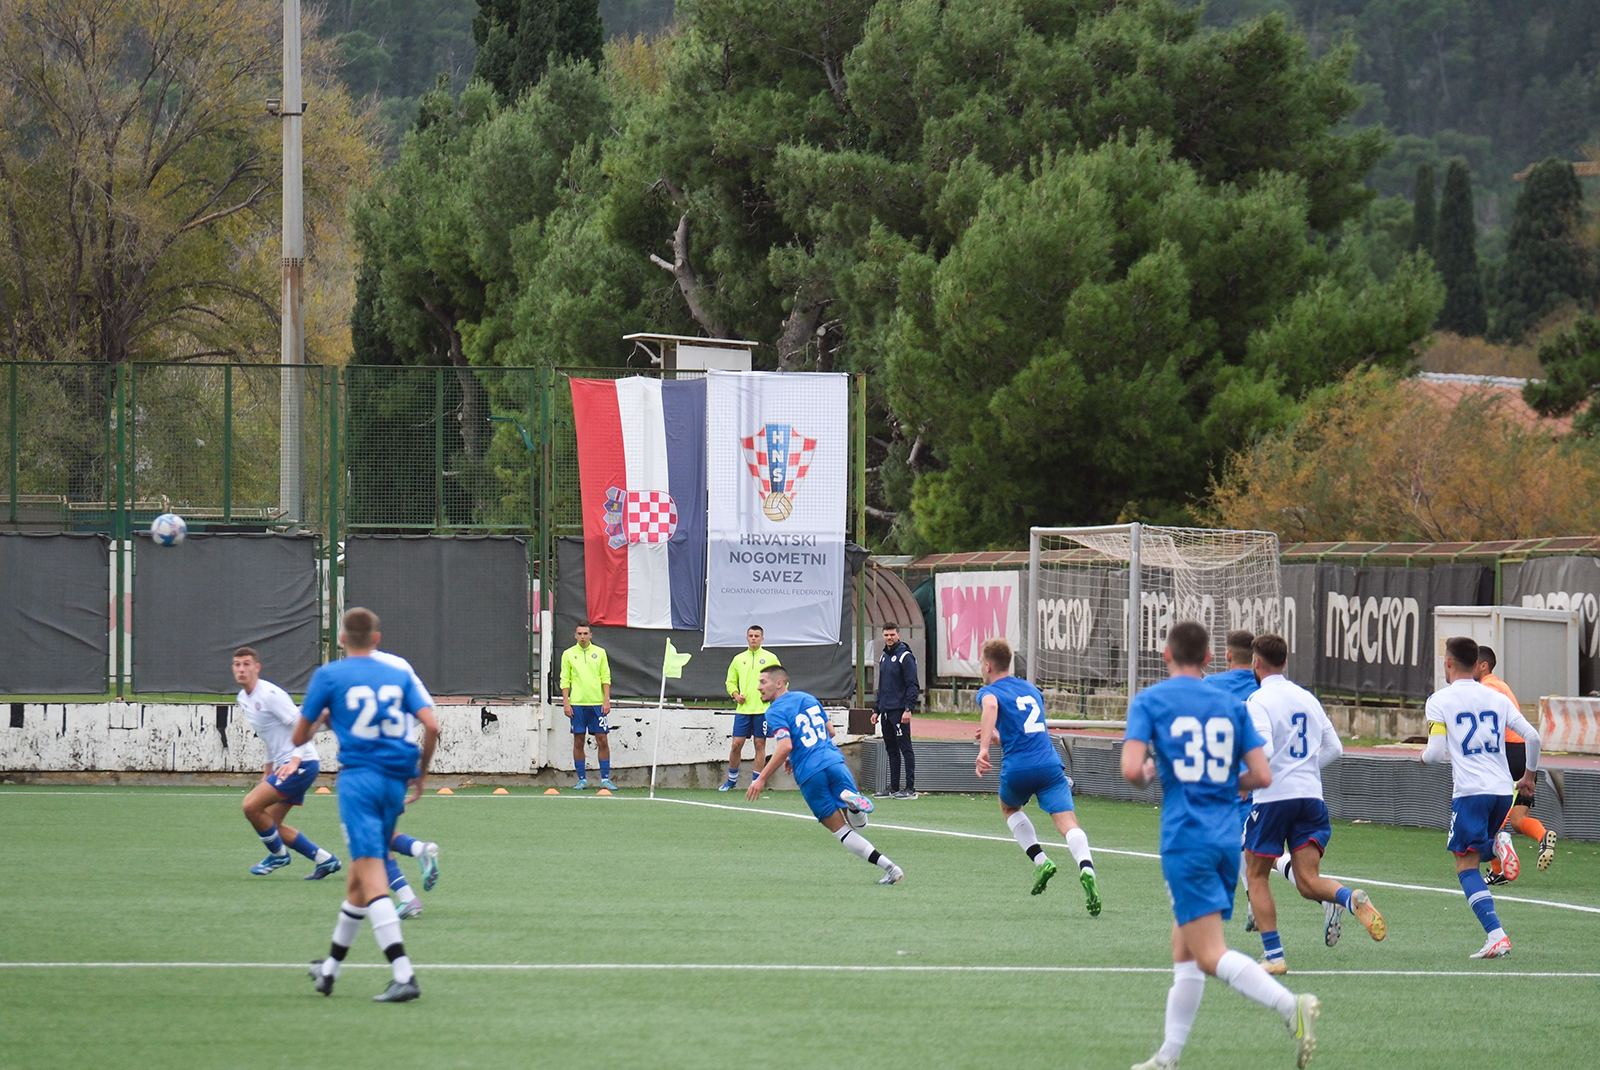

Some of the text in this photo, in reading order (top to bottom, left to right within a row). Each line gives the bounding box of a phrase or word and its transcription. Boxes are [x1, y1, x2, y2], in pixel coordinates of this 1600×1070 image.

[772, 430, 784, 483] HNS
[729, 551, 827, 566] NOGOMETNI
[740, 533, 817, 547] HRVATSKI
[720, 587, 755, 595] CROATIAN
[792, 588, 834, 596] FEDERATION
[752, 570, 804, 583] SAVEZ
[1325, 591, 1420, 666] macron
[345, 684, 408, 739] 23
[795, 704, 827, 748] 35
[1015, 695, 1046, 734] 2
[1455, 710, 1501, 756] 23
[1169, 716, 1235, 782] 39
[1289, 712, 1308, 758] 3
